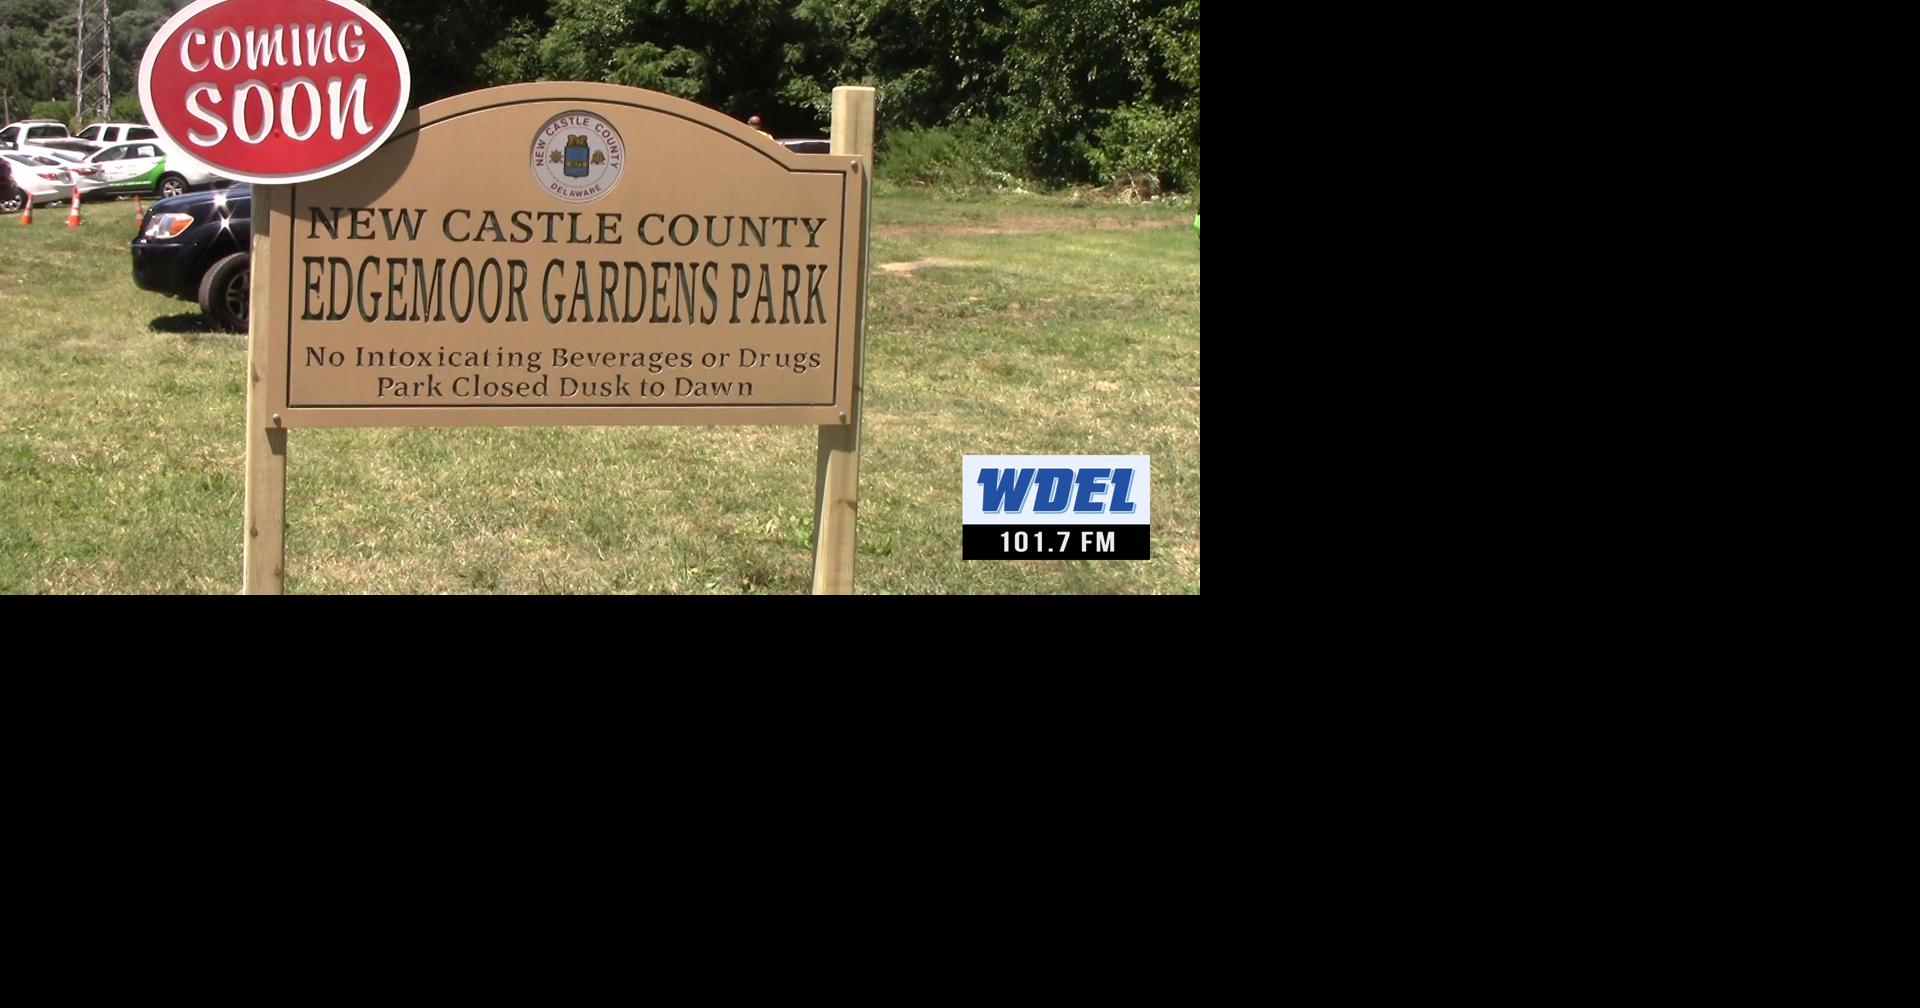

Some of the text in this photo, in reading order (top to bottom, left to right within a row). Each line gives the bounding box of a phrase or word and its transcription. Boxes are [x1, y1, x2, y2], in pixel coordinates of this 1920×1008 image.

[179, 20, 367, 73] COMING
[185, 75, 374, 147] SOON
[535, 117, 620, 169] NEW CASTLE COUNTY
[550, 182, 602, 198] DELAWARE
[307, 206, 827, 248] NEW CASTLE COUNTY
[301, 256, 828, 325] EDGEMOOR GARDENS PARK
[305, 346, 821, 374] No Intoxicating Beverages or Drugs
[377, 374, 754, 398] Park Closed Dusk to Dawn
